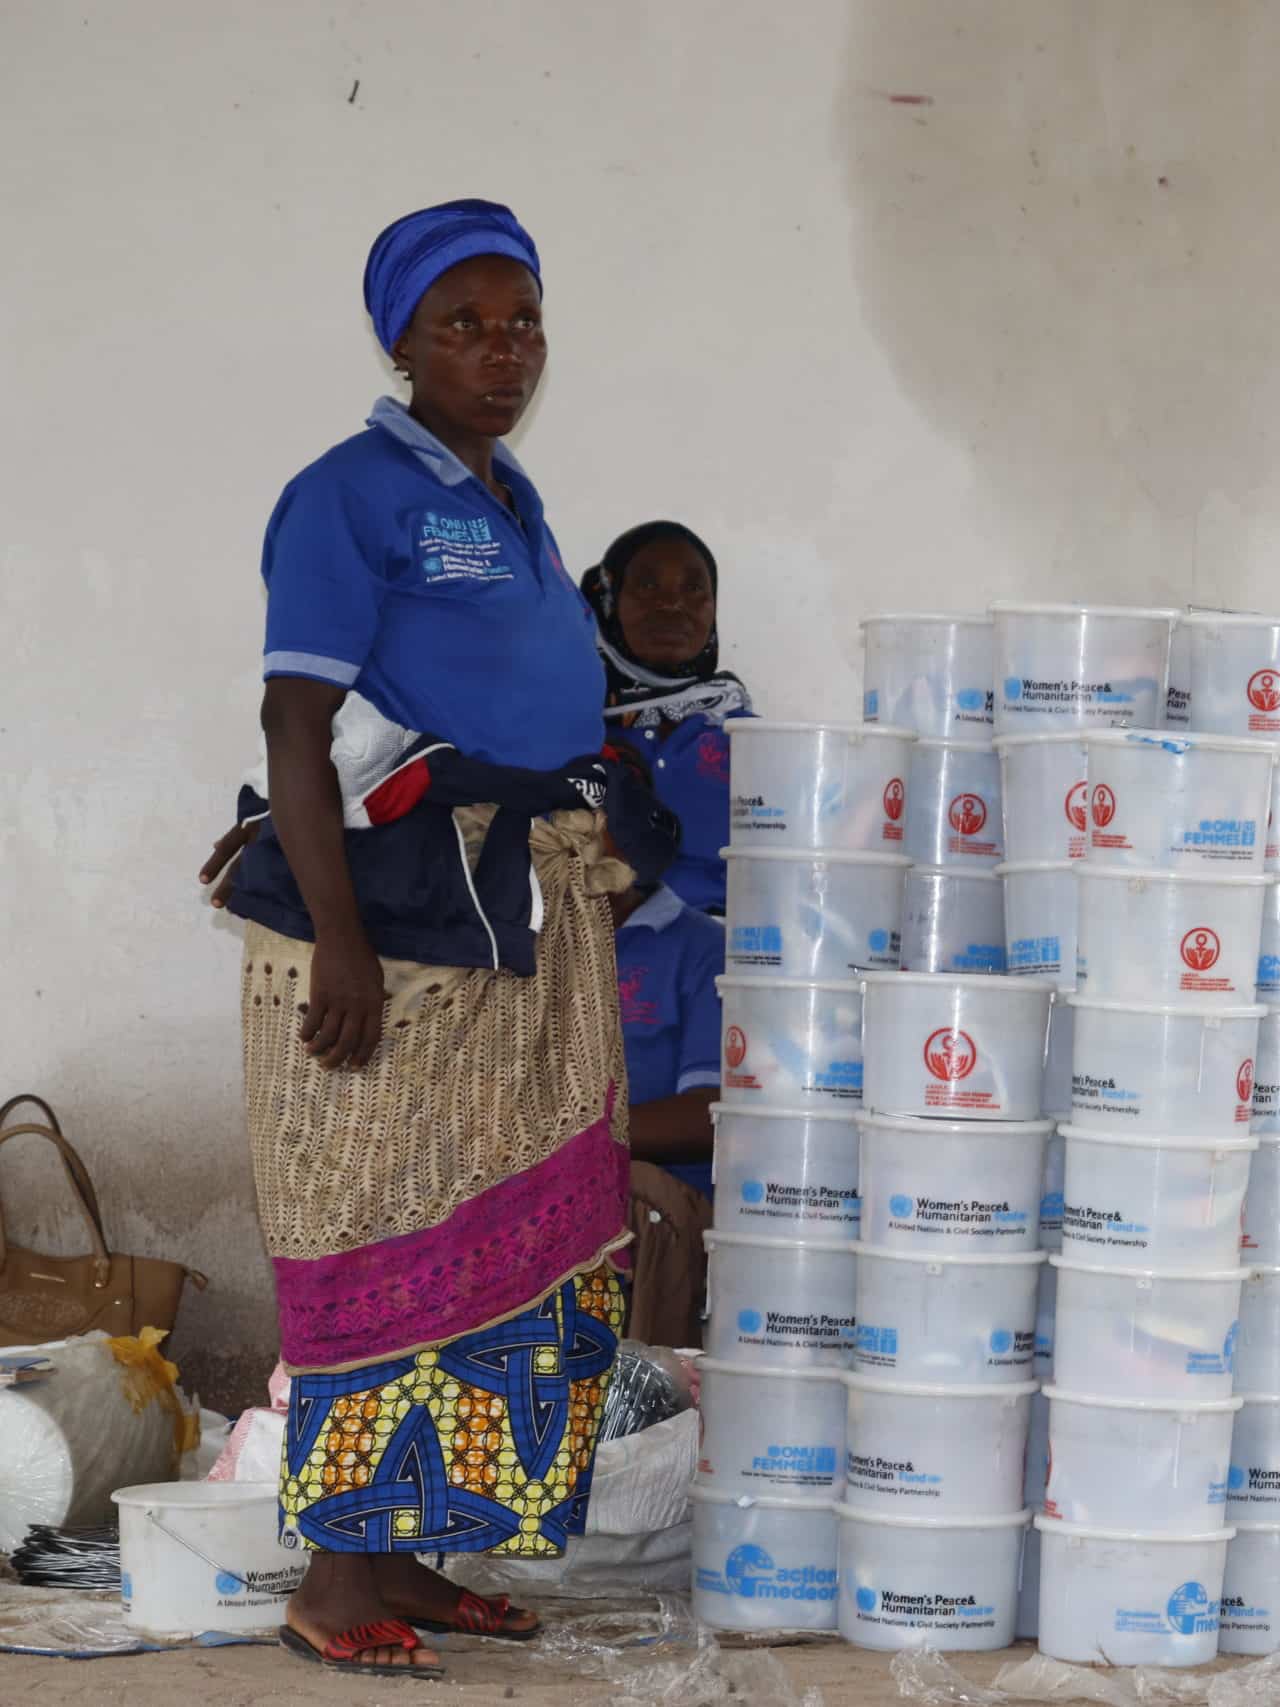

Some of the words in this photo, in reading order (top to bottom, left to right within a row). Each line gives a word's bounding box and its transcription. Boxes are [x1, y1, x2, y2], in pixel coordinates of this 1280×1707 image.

[440, 517, 467, 530] ONU
[1022, 679, 1068, 691] Women's
[1071, 681, 1112, 693] Pace&
[1022, 690, 1092, 703] Humanitarn
[1168, 688, 1191, 701] Peac
[1085, 1075, 1116, 1089] Peace&
[1102, 1103, 1141, 1115] Partnership
[766, 1184, 817, 1198] Women's
[820, 1187, 858, 1200] Peace&
[766, 1194, 840, 1208] Humantarian
[916, 1198, 969, 1212] Women's
[971, 1201, 1010, 1212] Peace&
[766, 1209, 793, 1219] Nations
[819, 1213, 843, 1223] Society
[916, 1210, 992, 1223] Humanitarian
[1086, 1208, 1122, 1222] Peace&
[894, 1222, 916, 1232] United
[917, 1225, 944, 1234] Nations
[953, 1226, 969, 1235] Civil
[970, 1227, 994, 1237] Society
[1107, 1236, 1148, 1248] Partnership
[767, 1312, 817, 1326] Women's
[766, 1324, 839, 1337] Humanitarian
[744, 1336, 765, 1345] United
[766, 1338, 793, 1347] Nations
[802, 1340, 818, 1349] Civil
[752, 1457, 816, 1472] FEMMES
[876, 1458, 914, 1473] Peace&
[877, 1485, 898, 1496] Society
[899, 1487, 941, 1497] Partnership
[1250, 1494, 1277, 1503] Nations
[246, 1567, 289, 1583] Women's
[776, 1566, 838, 1584] action
[757, 1583, 840, 1601] medeor
[881, 1591, 932, 1606] Women's
[935, 1594, 976, 1607] Peace&
[217, 1599, 223, 1607] A
[224, 1599, 246, 1608] United
[881, 1602, 955, 1616] Humanitarian
[882, 1616, 908, 1627] Nations
[917, 1619, 932, 1628] Civil
[934, 1620, 959, 1631] Society
[1232, 1622, 1270, 1631] Partnership
